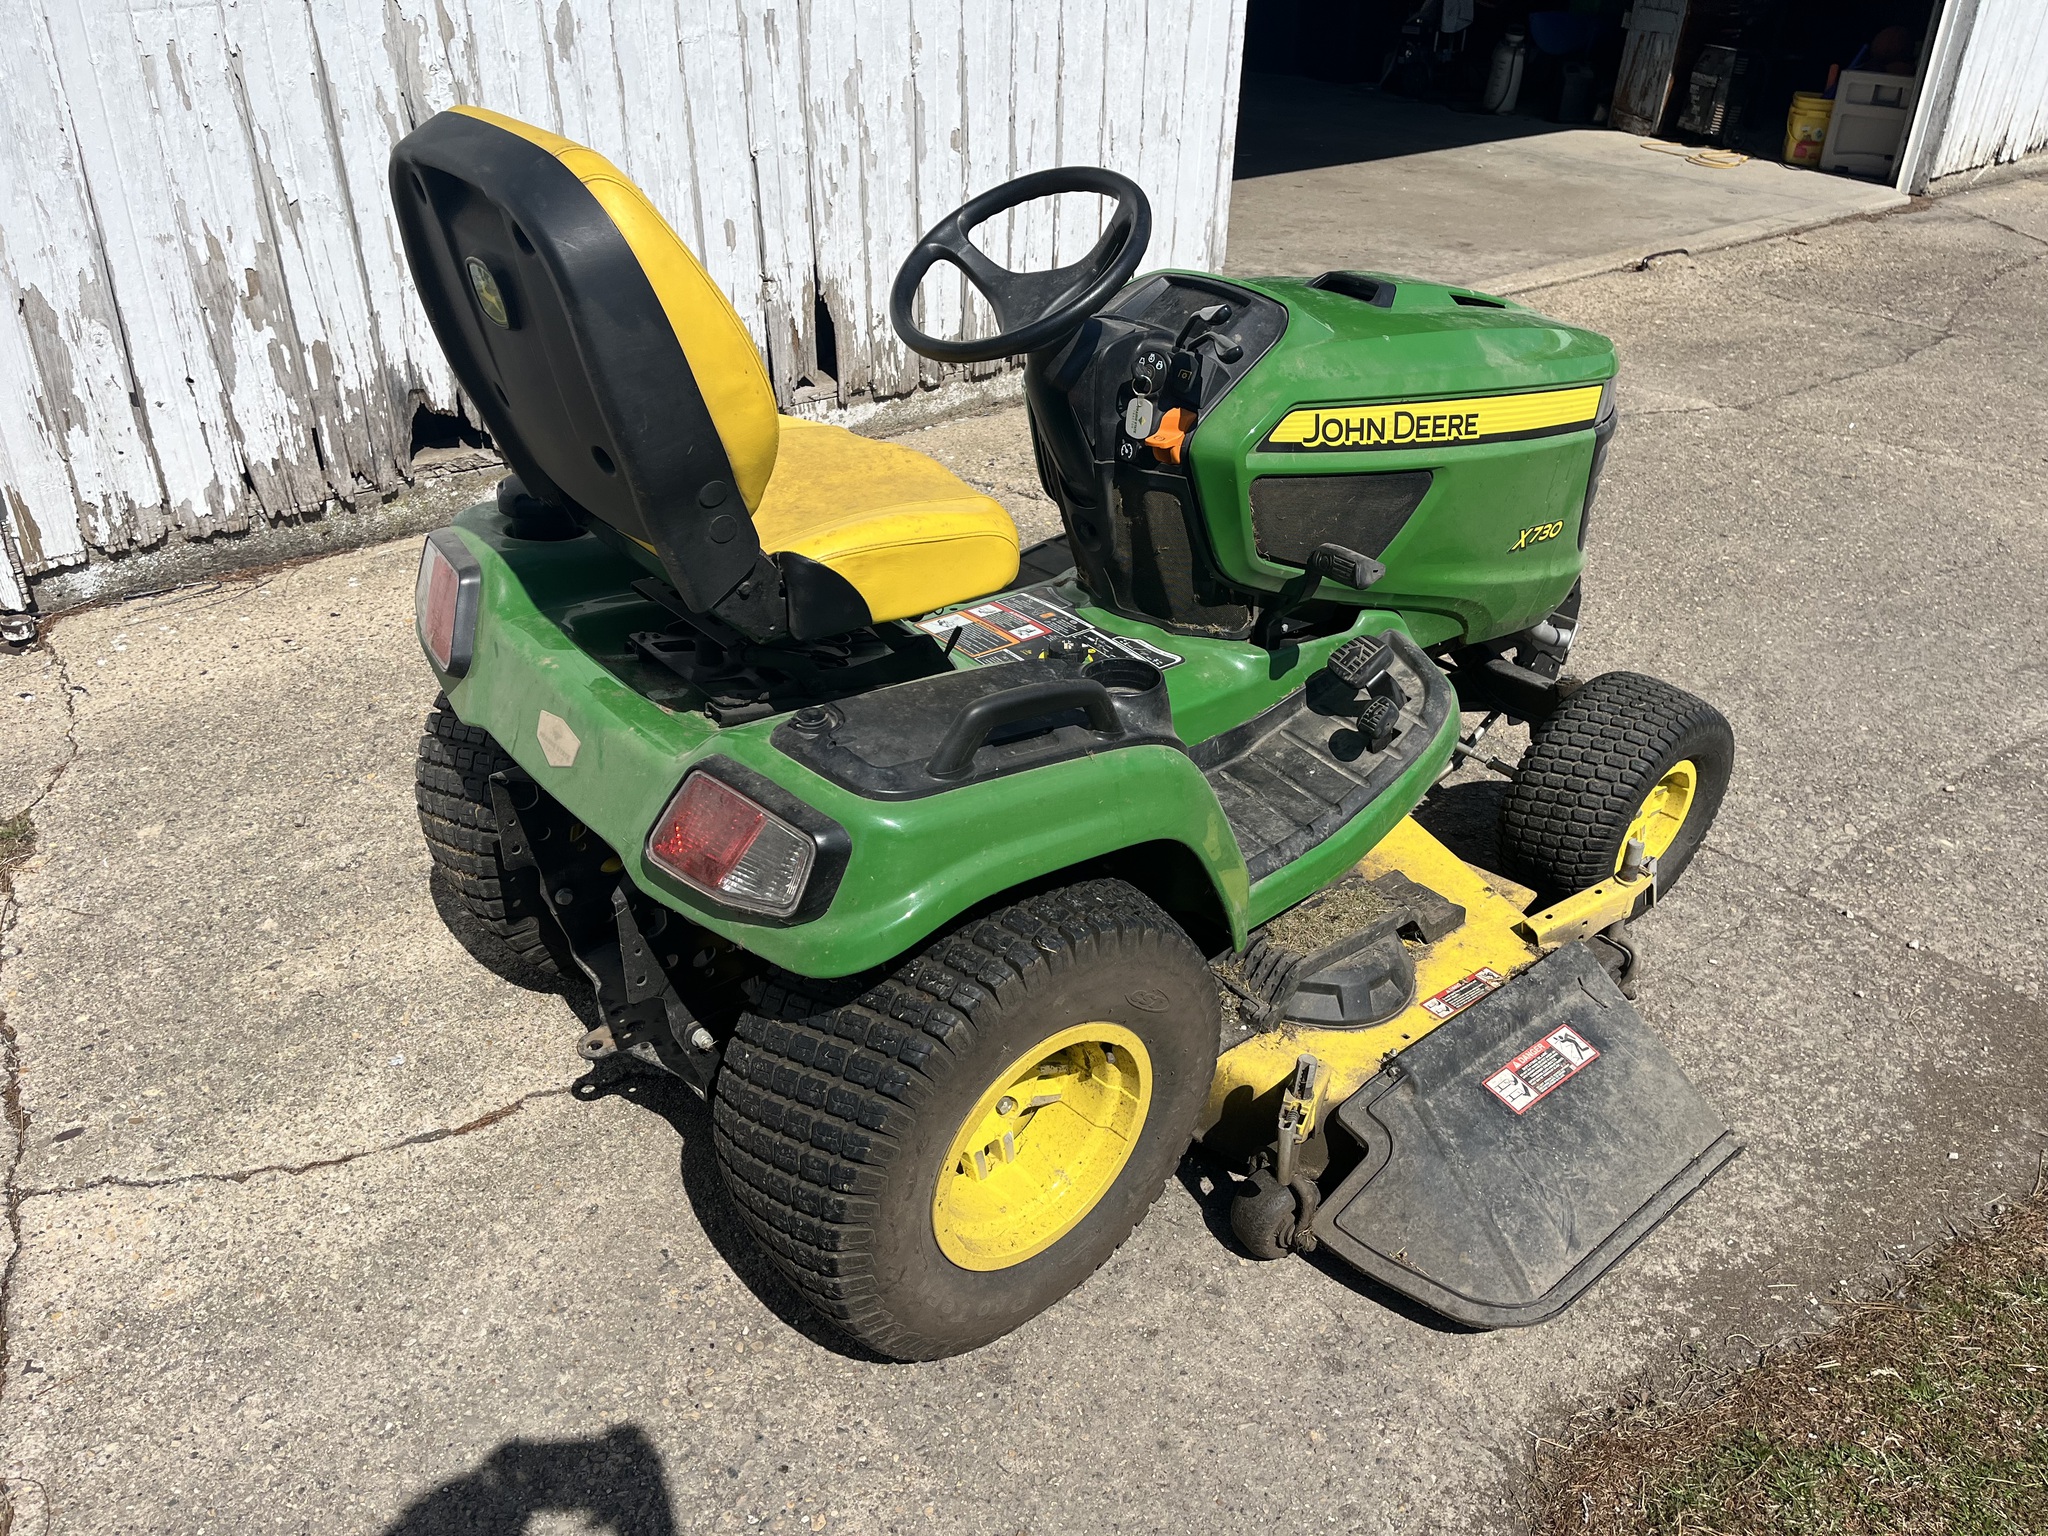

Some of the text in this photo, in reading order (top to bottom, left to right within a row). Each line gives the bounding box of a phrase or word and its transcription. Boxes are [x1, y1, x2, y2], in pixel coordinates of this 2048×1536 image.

[1302, 411, 1480, 444] JOHN DEERE
[1510, 519, 1564, 551] X730
[1518, 1043, 1546, 1064] DANGER
